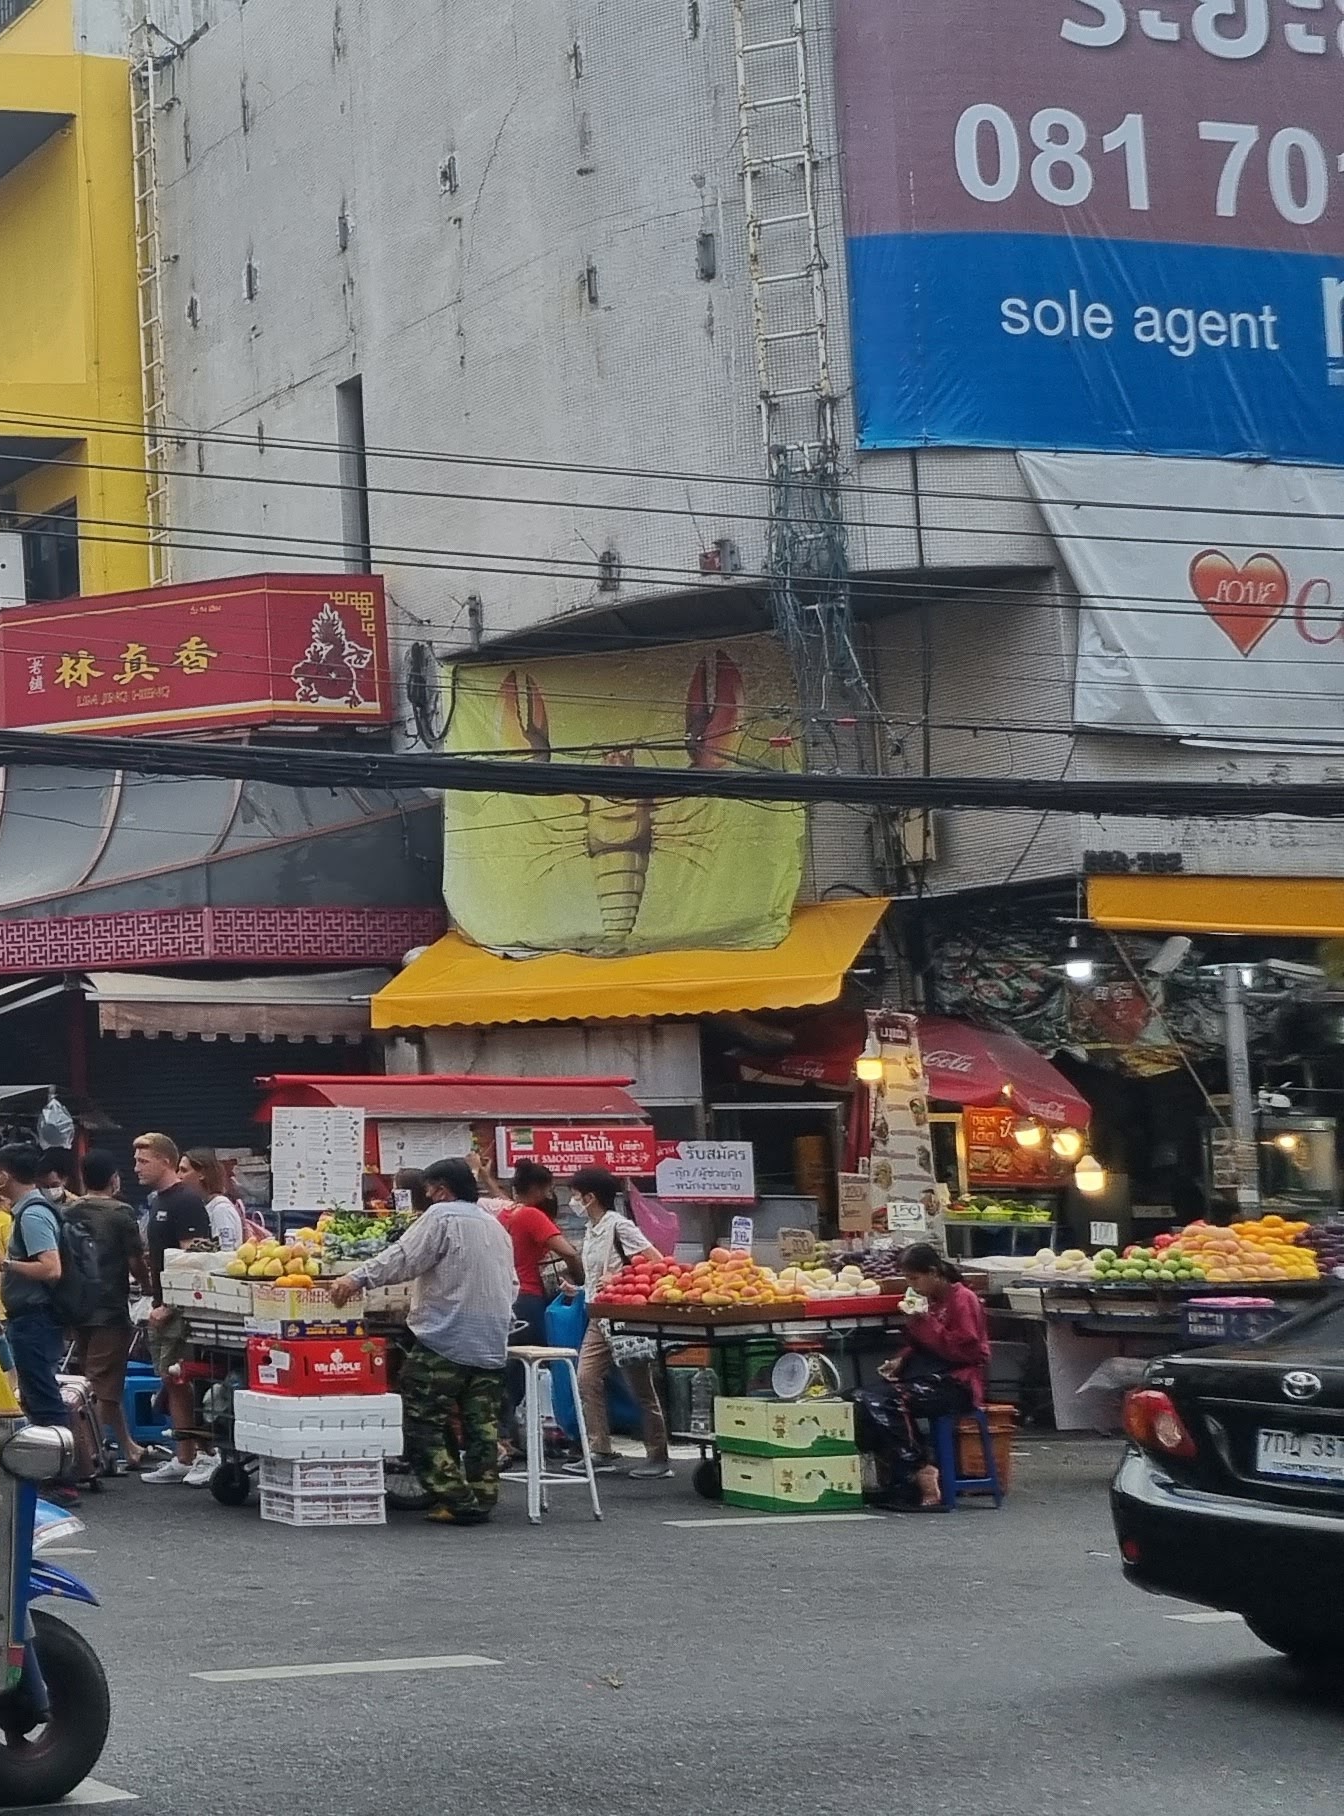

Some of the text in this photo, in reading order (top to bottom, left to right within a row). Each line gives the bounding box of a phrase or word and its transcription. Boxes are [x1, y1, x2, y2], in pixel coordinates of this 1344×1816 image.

[954, 103, 1344, 225] 081 70
[1000, 289, 1113, 340] sole
[1133, 305, 1279, 358] agent
[54, 635, 218, 690] 林真香
[685, 1144, 746, 1161] รับสมัคร
[330, 1361, 361, 1371] APPLE
